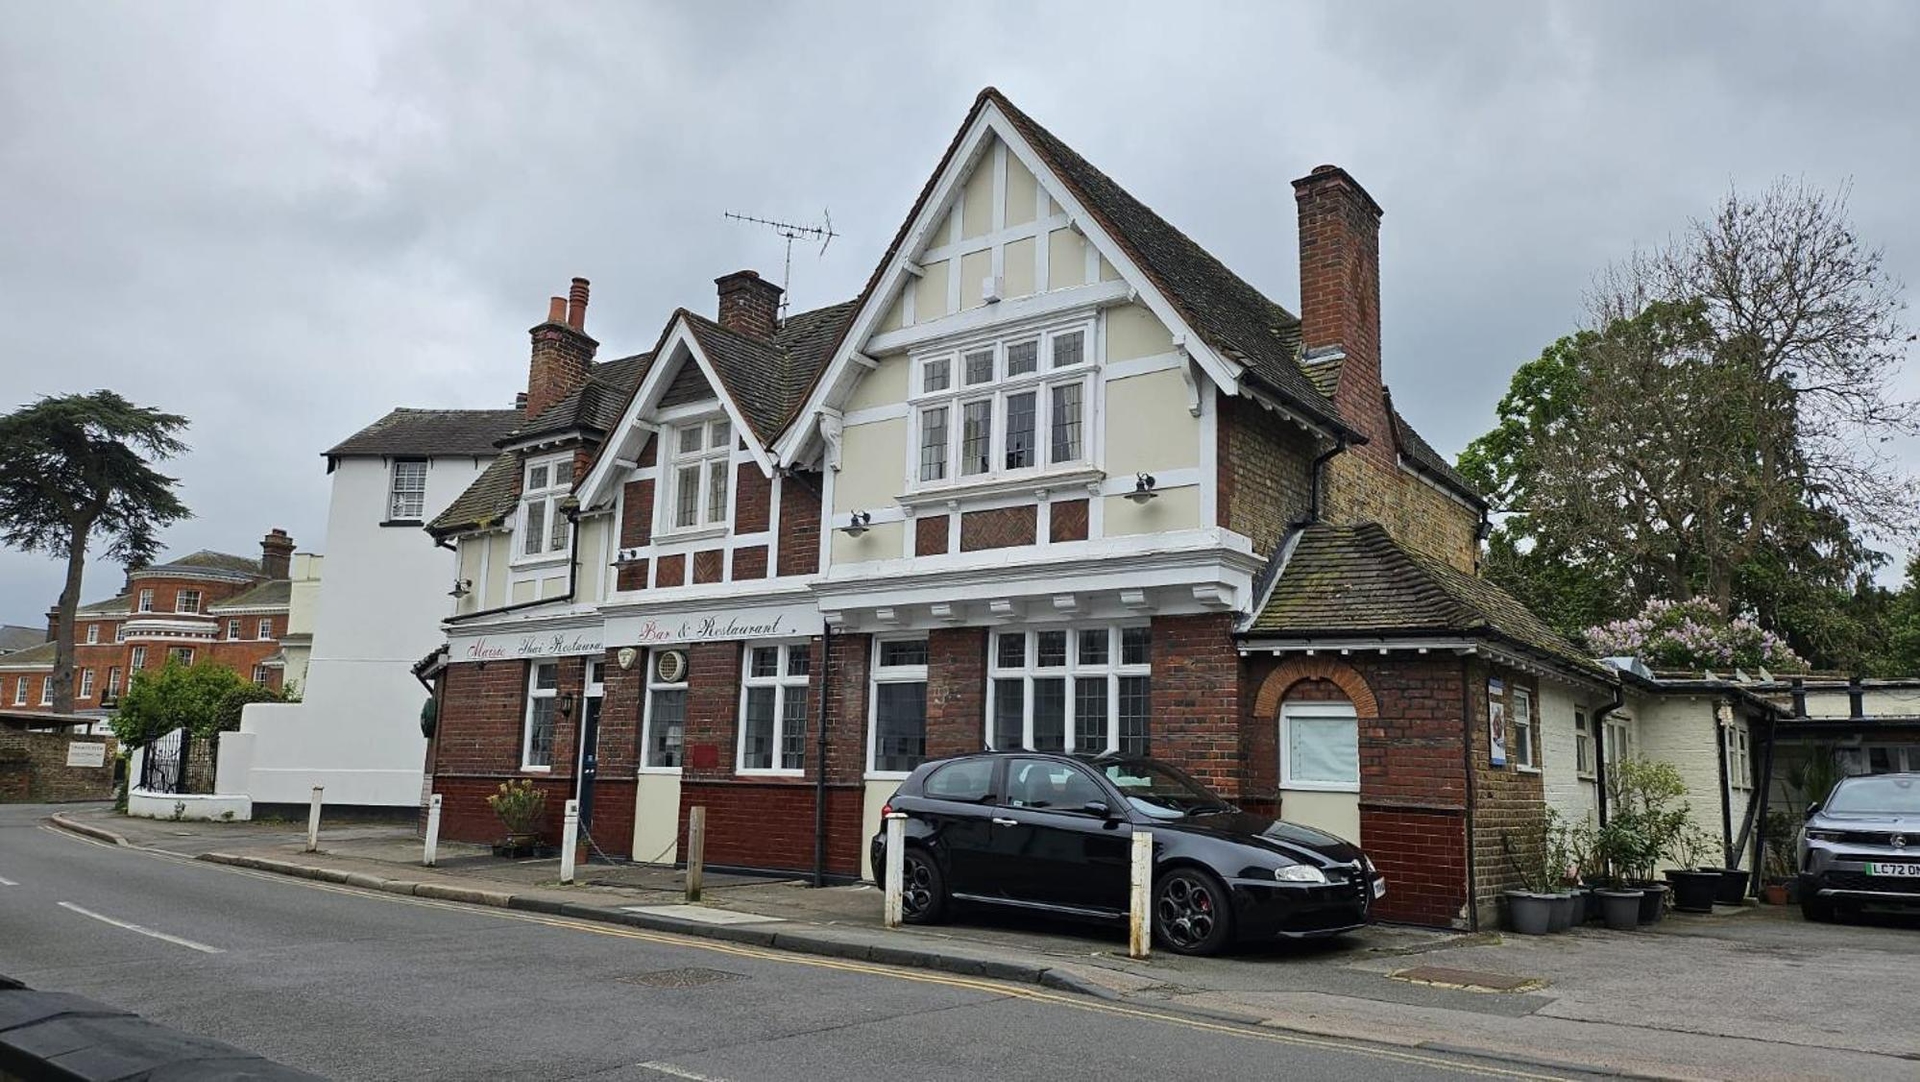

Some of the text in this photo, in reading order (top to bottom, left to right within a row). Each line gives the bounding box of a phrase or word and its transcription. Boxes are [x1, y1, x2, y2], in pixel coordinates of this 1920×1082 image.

[639, 614, 783, 640] Bar & Restaurant
[518, 636, 544, 655] Thai
[549, 631, 605, 653] Restaura
[1873, 864, 1905, 875] LC72
